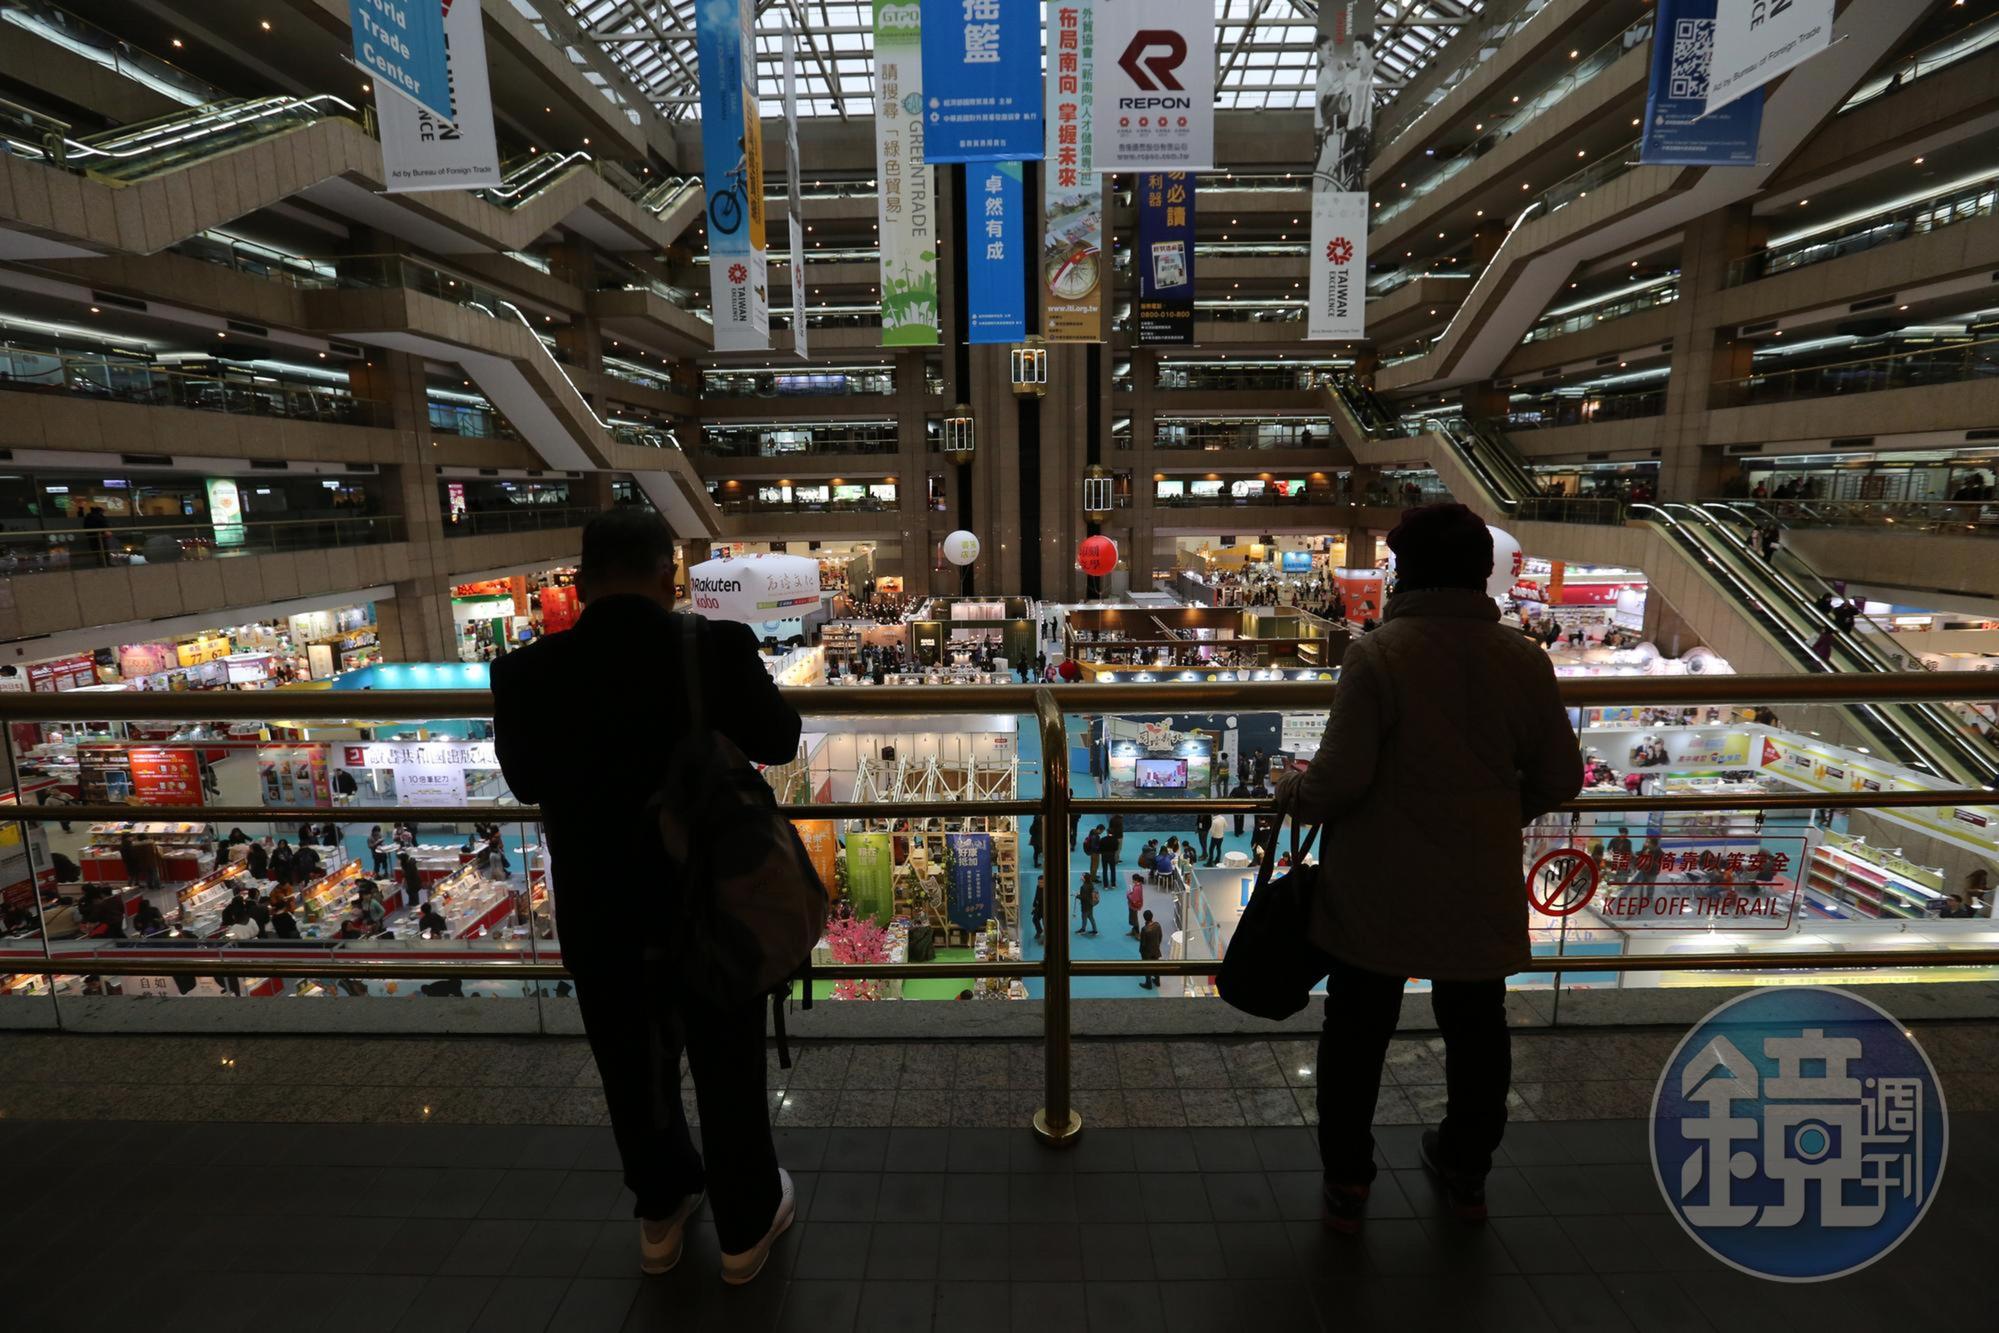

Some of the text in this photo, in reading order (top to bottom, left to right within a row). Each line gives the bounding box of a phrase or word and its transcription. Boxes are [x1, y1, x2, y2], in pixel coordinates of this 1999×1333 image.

[359, 8, 410, 60] Trade
[363, 43, 420, 95] Center
[1058, 7, 1078, 187] 布局南向 掌握未來
[1120, 97, 1190, 109] REPON
[413, 169, 436, 177] Bureau
[446, 167, 472, 177] Foreign
[473, 166, 492, 174] Trade
[909, 120, 927, 237] GREENTRADE
[985, 175, 1004, 260] 卓然有成
[738, 286, 747, 322] TAIWAN
[1336, 268, 1348, 318] TAIWAN
[694, 577, 741, 592] Rakuten
[695, 594, 719, 609] kobo
[1611, 852, 1790, 872] 請勿倚靠以策安全
[1602, 896, 1780, 916] KEEP OFF THE RAIL
